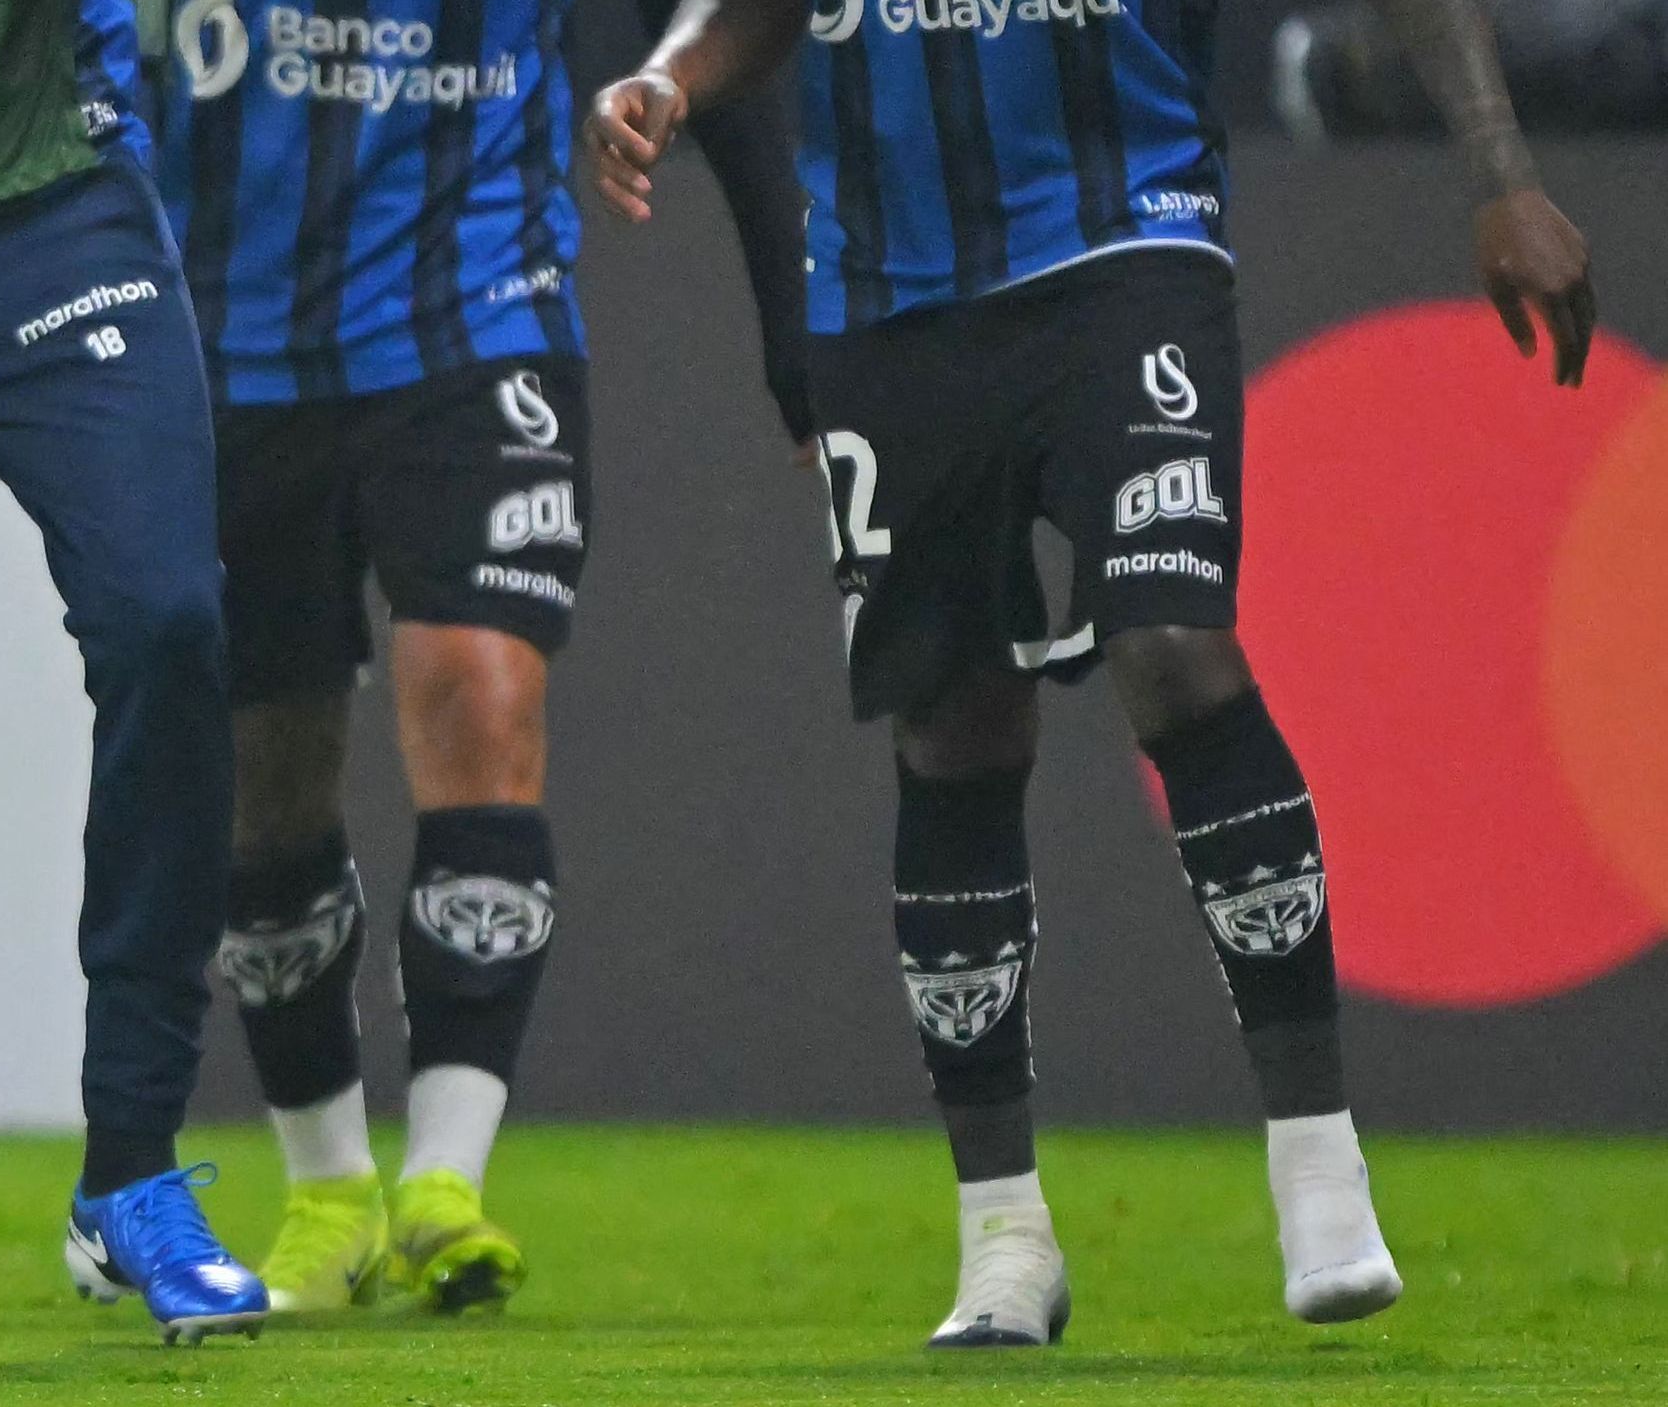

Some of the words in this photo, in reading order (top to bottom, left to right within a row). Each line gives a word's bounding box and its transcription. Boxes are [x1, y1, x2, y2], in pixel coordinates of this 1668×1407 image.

[269, 5, 434, 58] Banco
[269, 50, 517, 114] Guayaquil
[17, 280, 159, 347] marathon
[87, 325, 127, 362] 18
[488, 480, 583, 553] GOL
[1115, 457, 1228, 533] GOL
[1106, 549, 1224, 585] marathon
